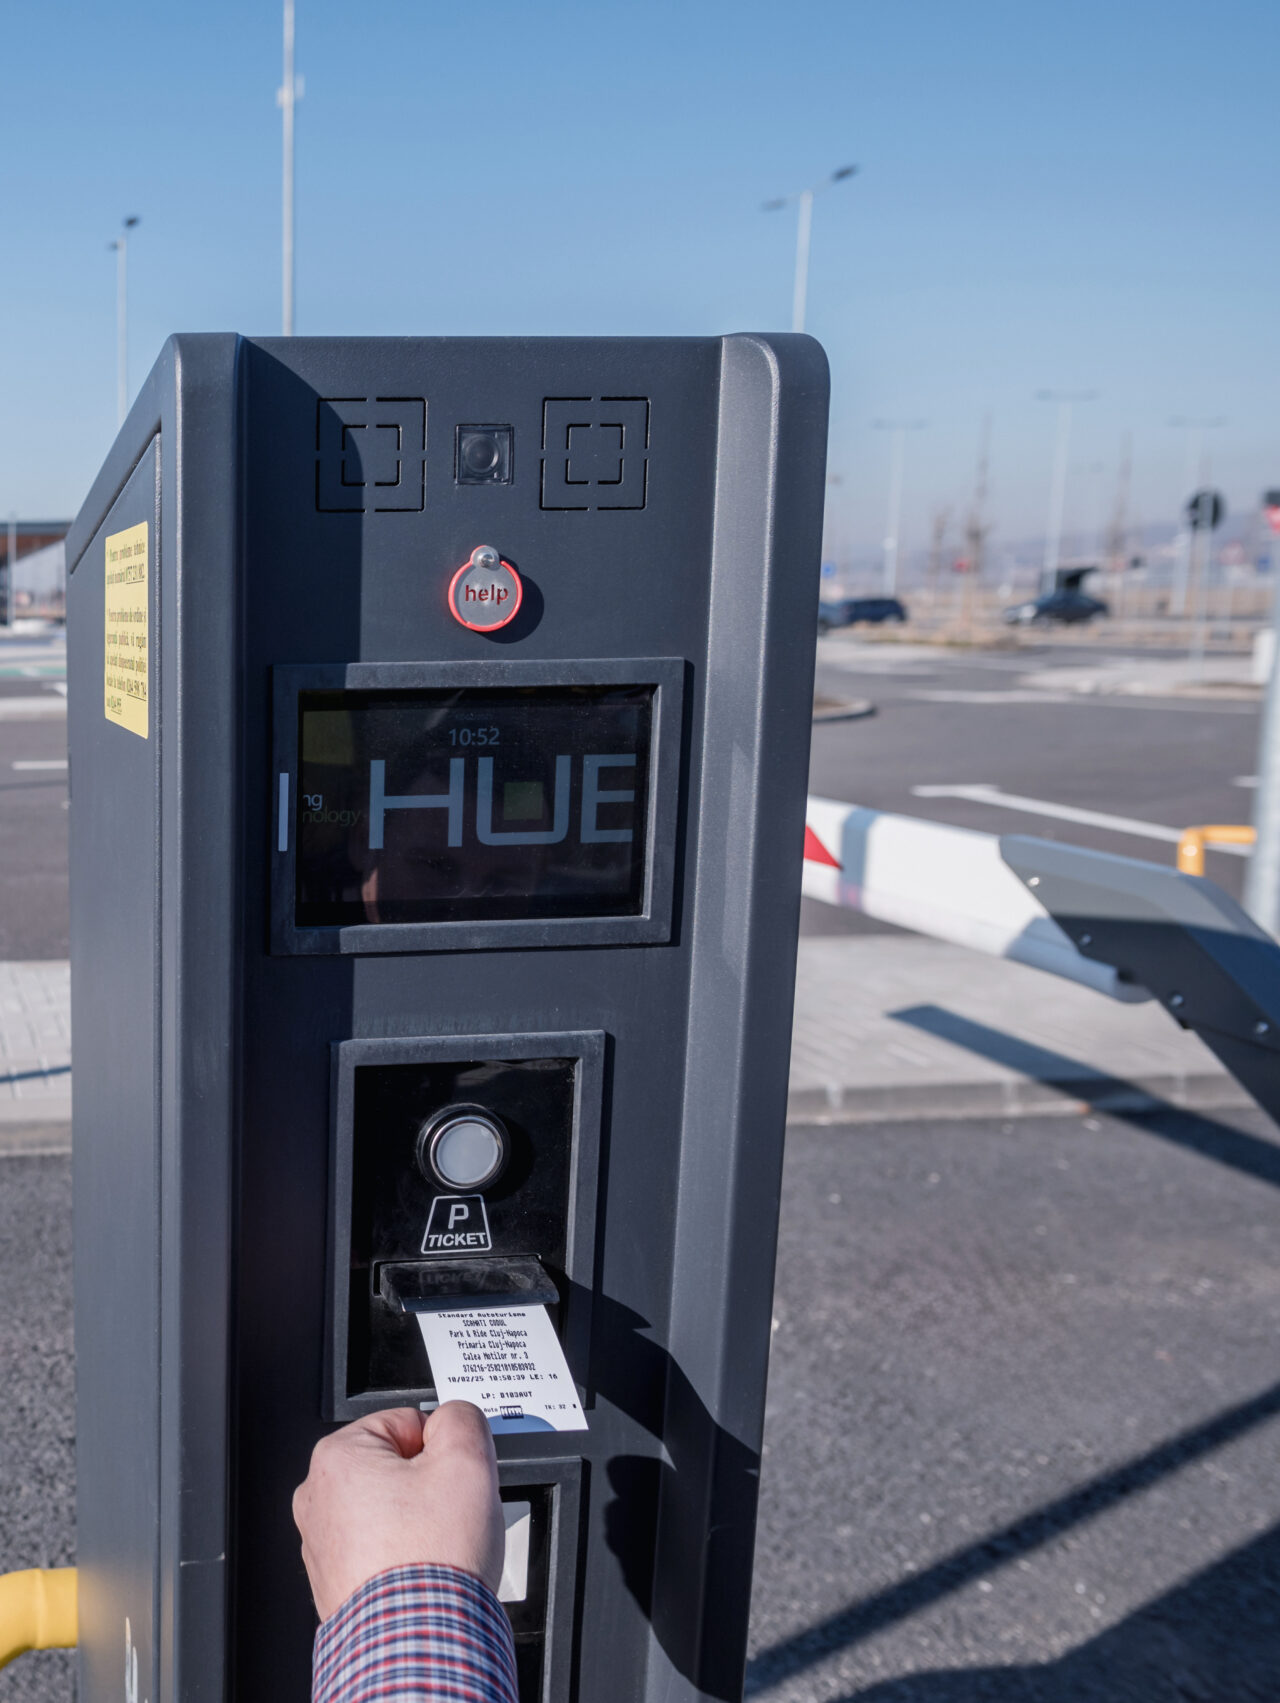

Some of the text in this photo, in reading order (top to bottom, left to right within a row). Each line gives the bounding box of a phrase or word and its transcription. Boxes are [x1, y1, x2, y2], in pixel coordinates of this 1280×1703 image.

[465, 584, 508, 605] help
[448, 728, 500, 746] 10:52
[448, 1204, 469, 1229] P
[429, 1232, 486, 1247] TICKET
[449, 1329, 464, 1338] Park
[473, 1329, 487, 1338] Ride
[490, 1328, 528, 1339] Cluj-Napoca
[458, 1339, 527, 1350] Primaria Cluj-Napoca
[463, 1352, 481, 1361] Calea
[483, 1351, 508, 1360] Motilor
[523, 1351, 529, 1359] 3
